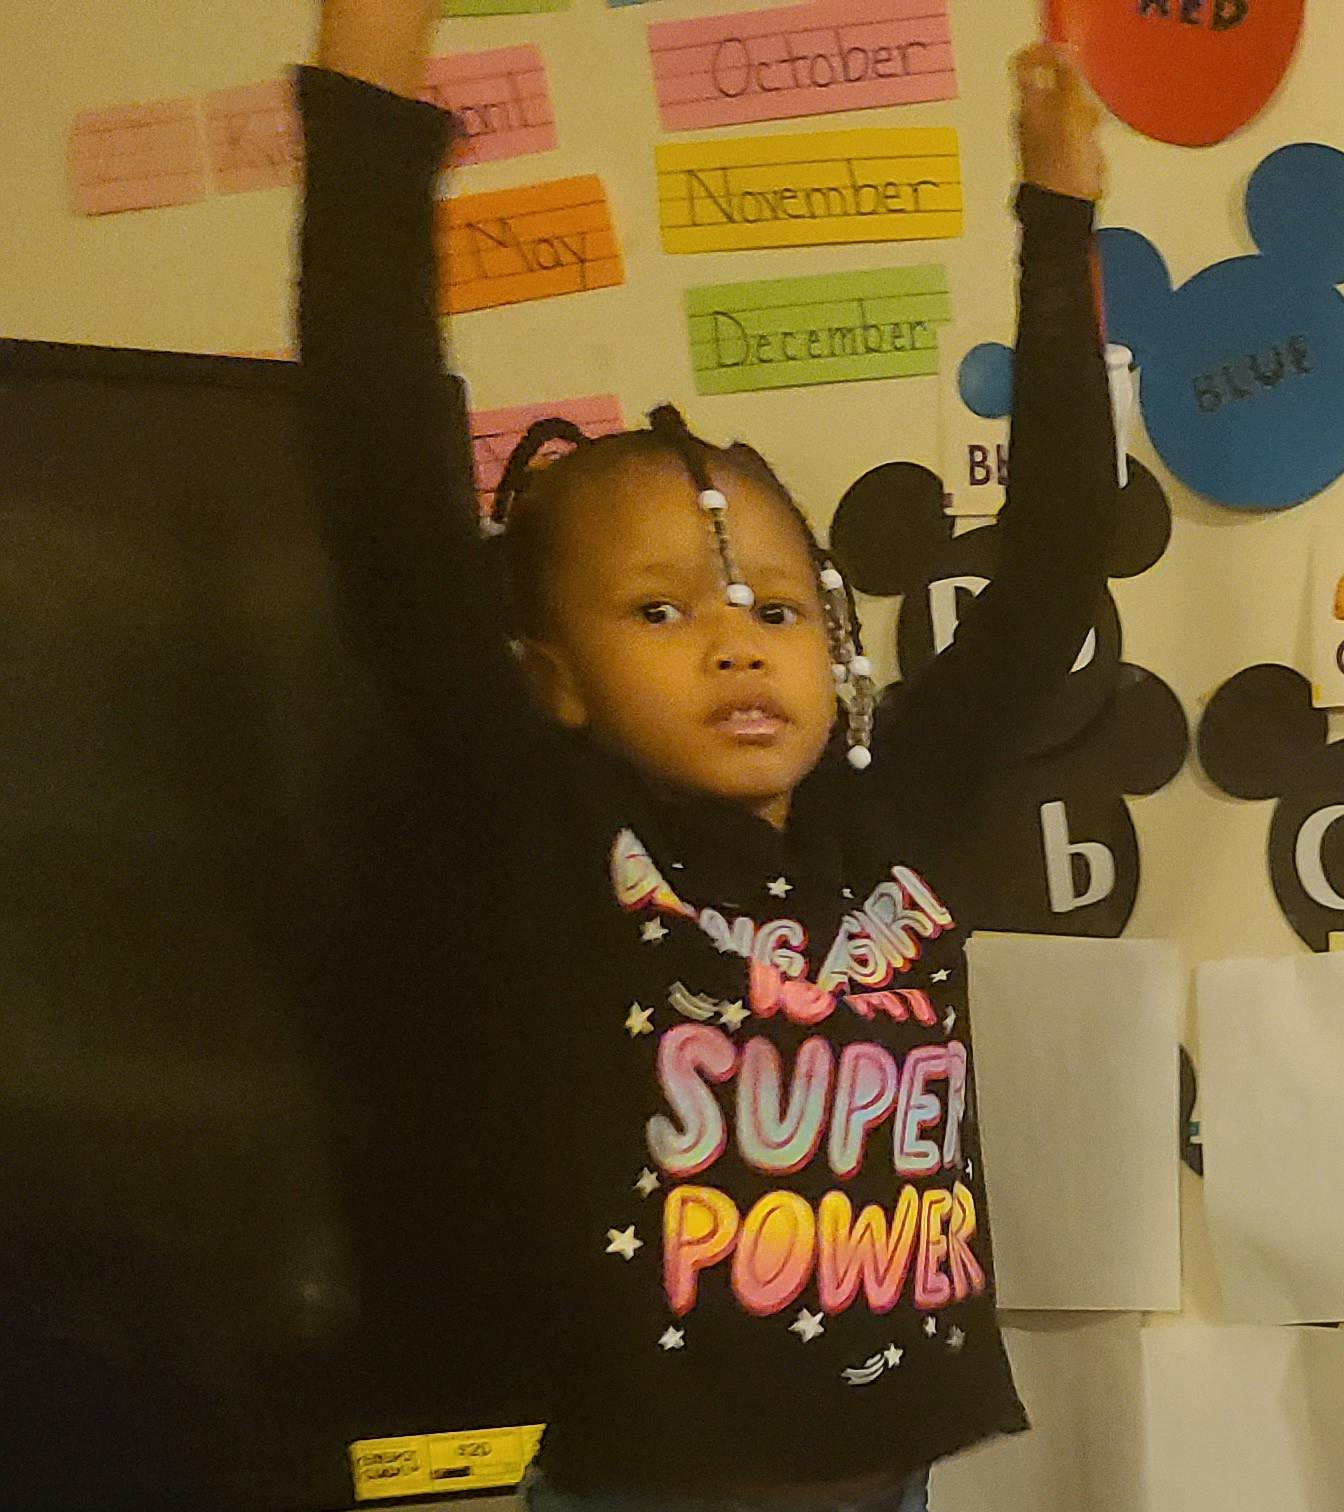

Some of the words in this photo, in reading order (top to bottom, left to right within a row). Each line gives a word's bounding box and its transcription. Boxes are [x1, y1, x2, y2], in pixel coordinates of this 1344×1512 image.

[712, 25, 928, 97] October
[685, 158, 940, 226] November
[466, 217, 588, 291] May
[712, 298, 928, 369] December
[1192, 336, 1313, 416] BLUE
[663, 1180, 987, 1316] POWER
